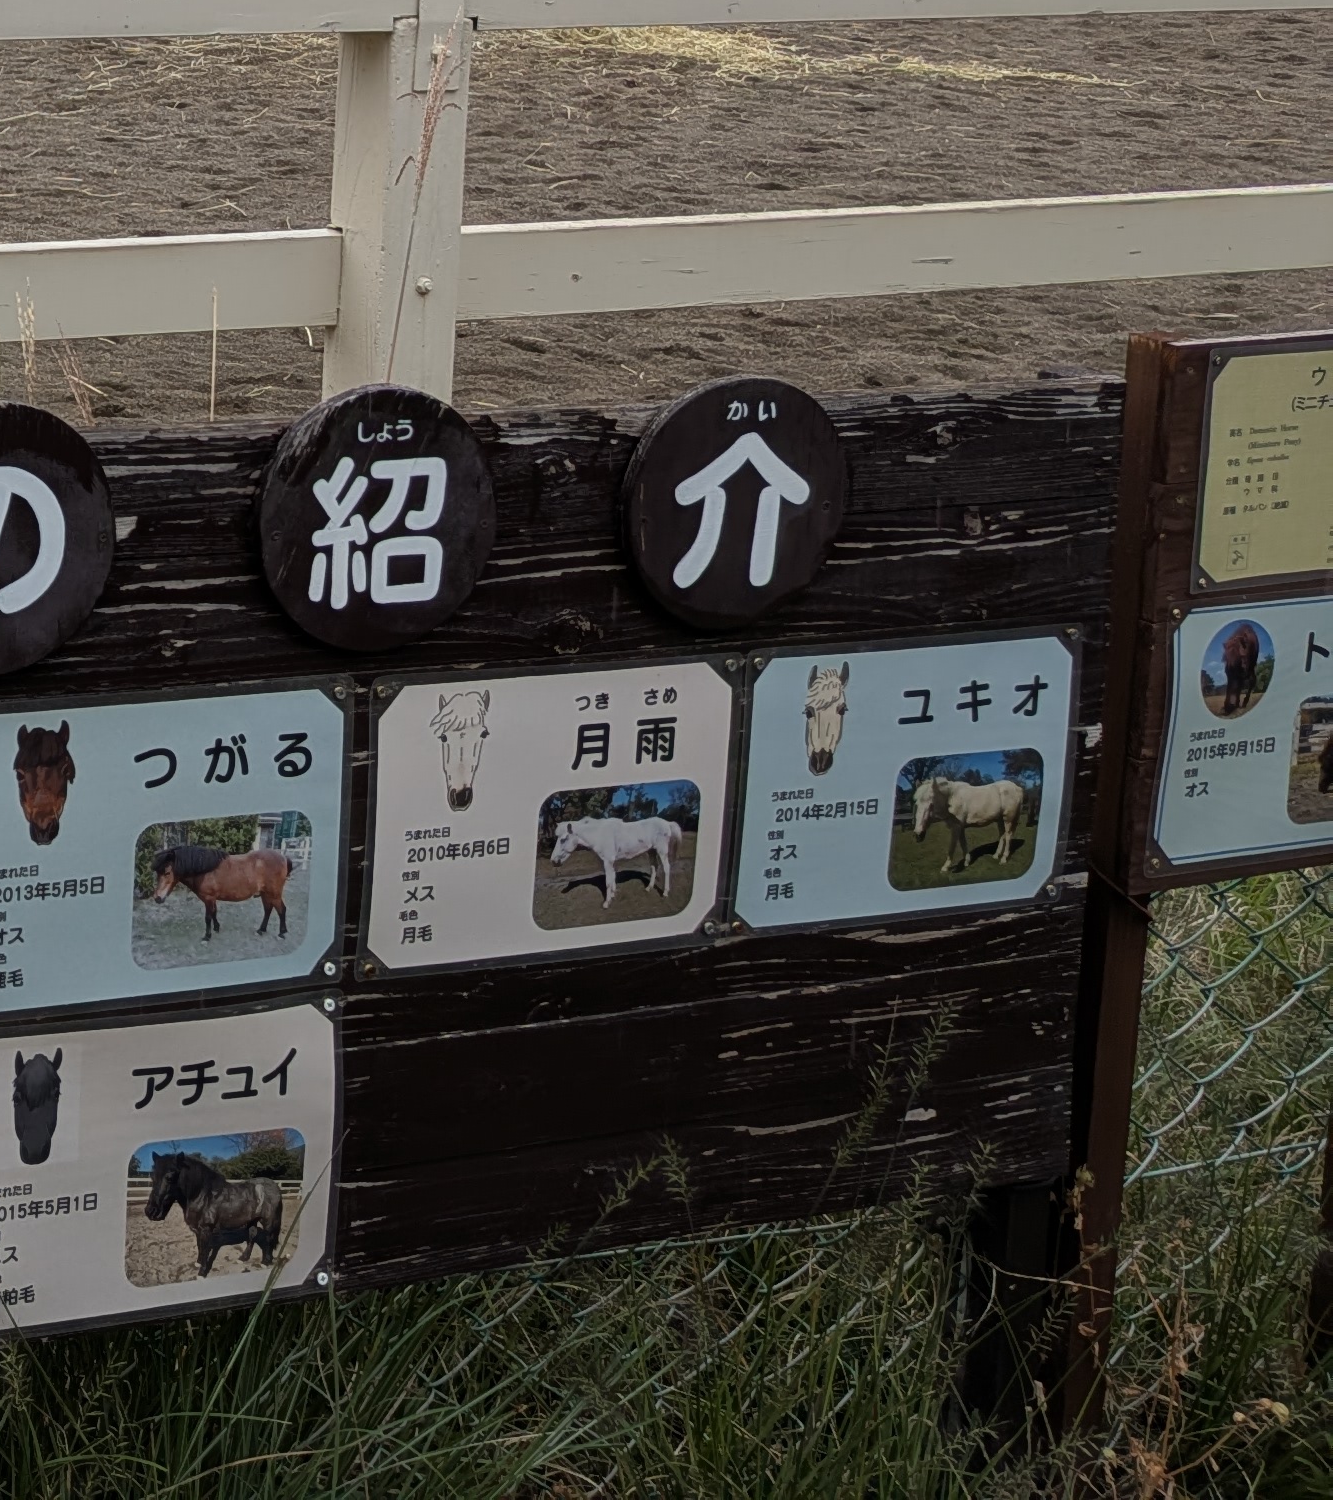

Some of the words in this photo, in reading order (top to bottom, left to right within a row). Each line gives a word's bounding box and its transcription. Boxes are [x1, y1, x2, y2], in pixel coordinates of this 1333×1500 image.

[725, 399, 778, 423] かい
[355, 419, 416, 443] しょう
[897, 674, 1049, 725] ユキオ
[571, 716, 678, 771] 月雨
[1189, 728, 1225, 742] うまれた日
[1186, 736, 1276, 762] 2015年9月15日
[133, 731, 313, 790] つがる
[771, 788, 814, 802] うまれた日
[1184, 781, 1209, 798] オス
[775, 799, 879, 823] 2014年2月15日
[404, 826, 451, 842] うまれた日
[406, 837, 511, 864] 2010年6月6日
[769, 844, 798, 861] オス
[401, 870, 420, 882] 性別
[763, 867, 782, 878] 毛色
[403, 885, 436, 904] メス
[764, 881, 794, 901] 月毛
[398, 909, 419, 922] 毛色
[400, 924, 433, 945] 月毛
[131, 1047, 298, 1110] アチュイ
